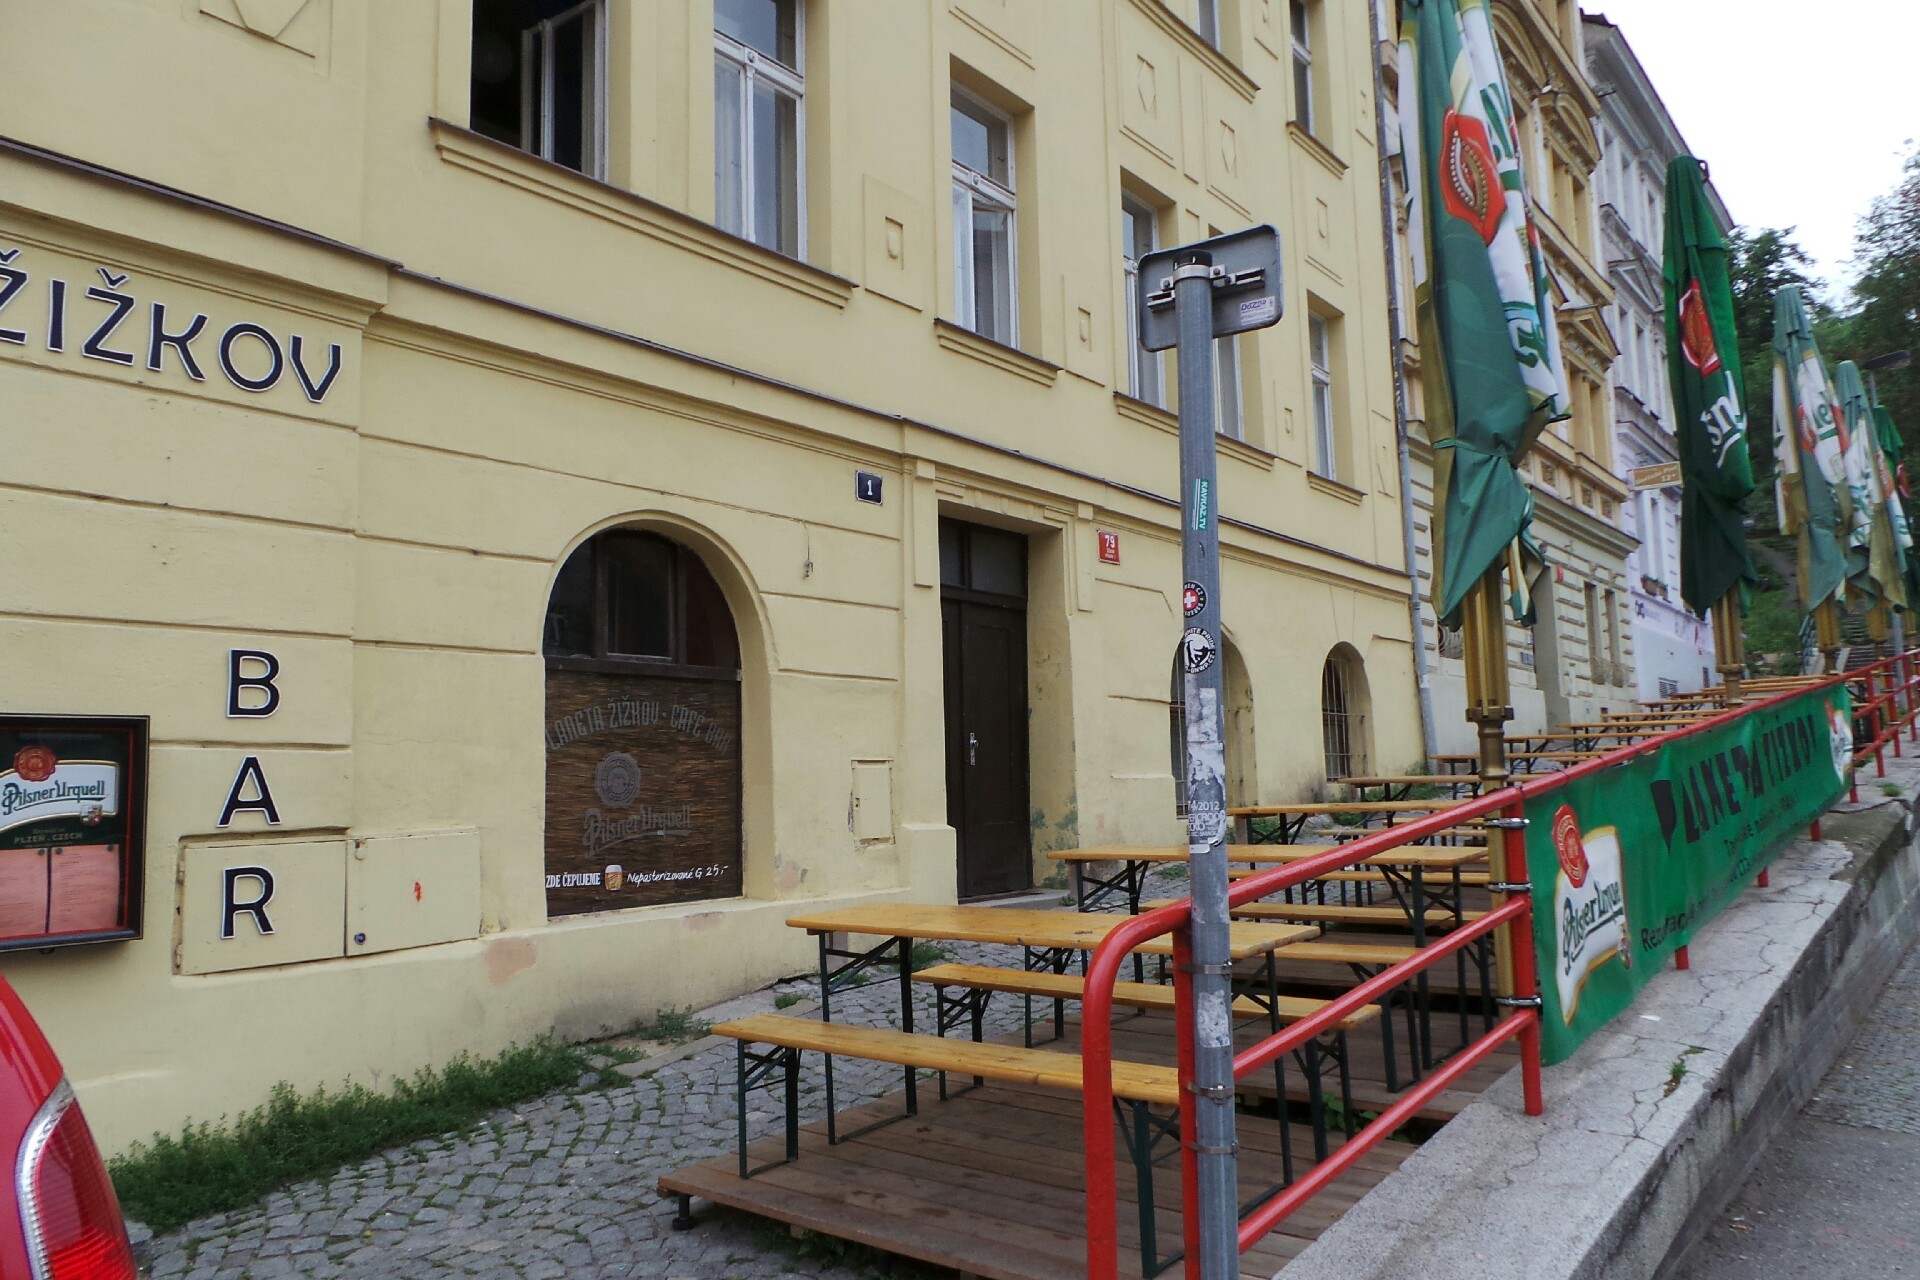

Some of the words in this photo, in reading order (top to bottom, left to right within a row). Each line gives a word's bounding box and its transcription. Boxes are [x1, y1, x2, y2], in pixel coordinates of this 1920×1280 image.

[867, 479, 873, 496] 1
[1199, 481, 1208, 529] KAVKAZ.TV
[1104, 534, 1115, 548] 79
[545, 706, 605, 751] LANETA
[2, 783, 56, 816] Pilsner
[55, 780, 105, 804] Urquell
[581, 807, 642, 859] Pilsner
[639, 804, 693, 833] Urquell
[545, 874, 562, 889] ZDE
[562, 871, 602, 887] ČEPUJEME
